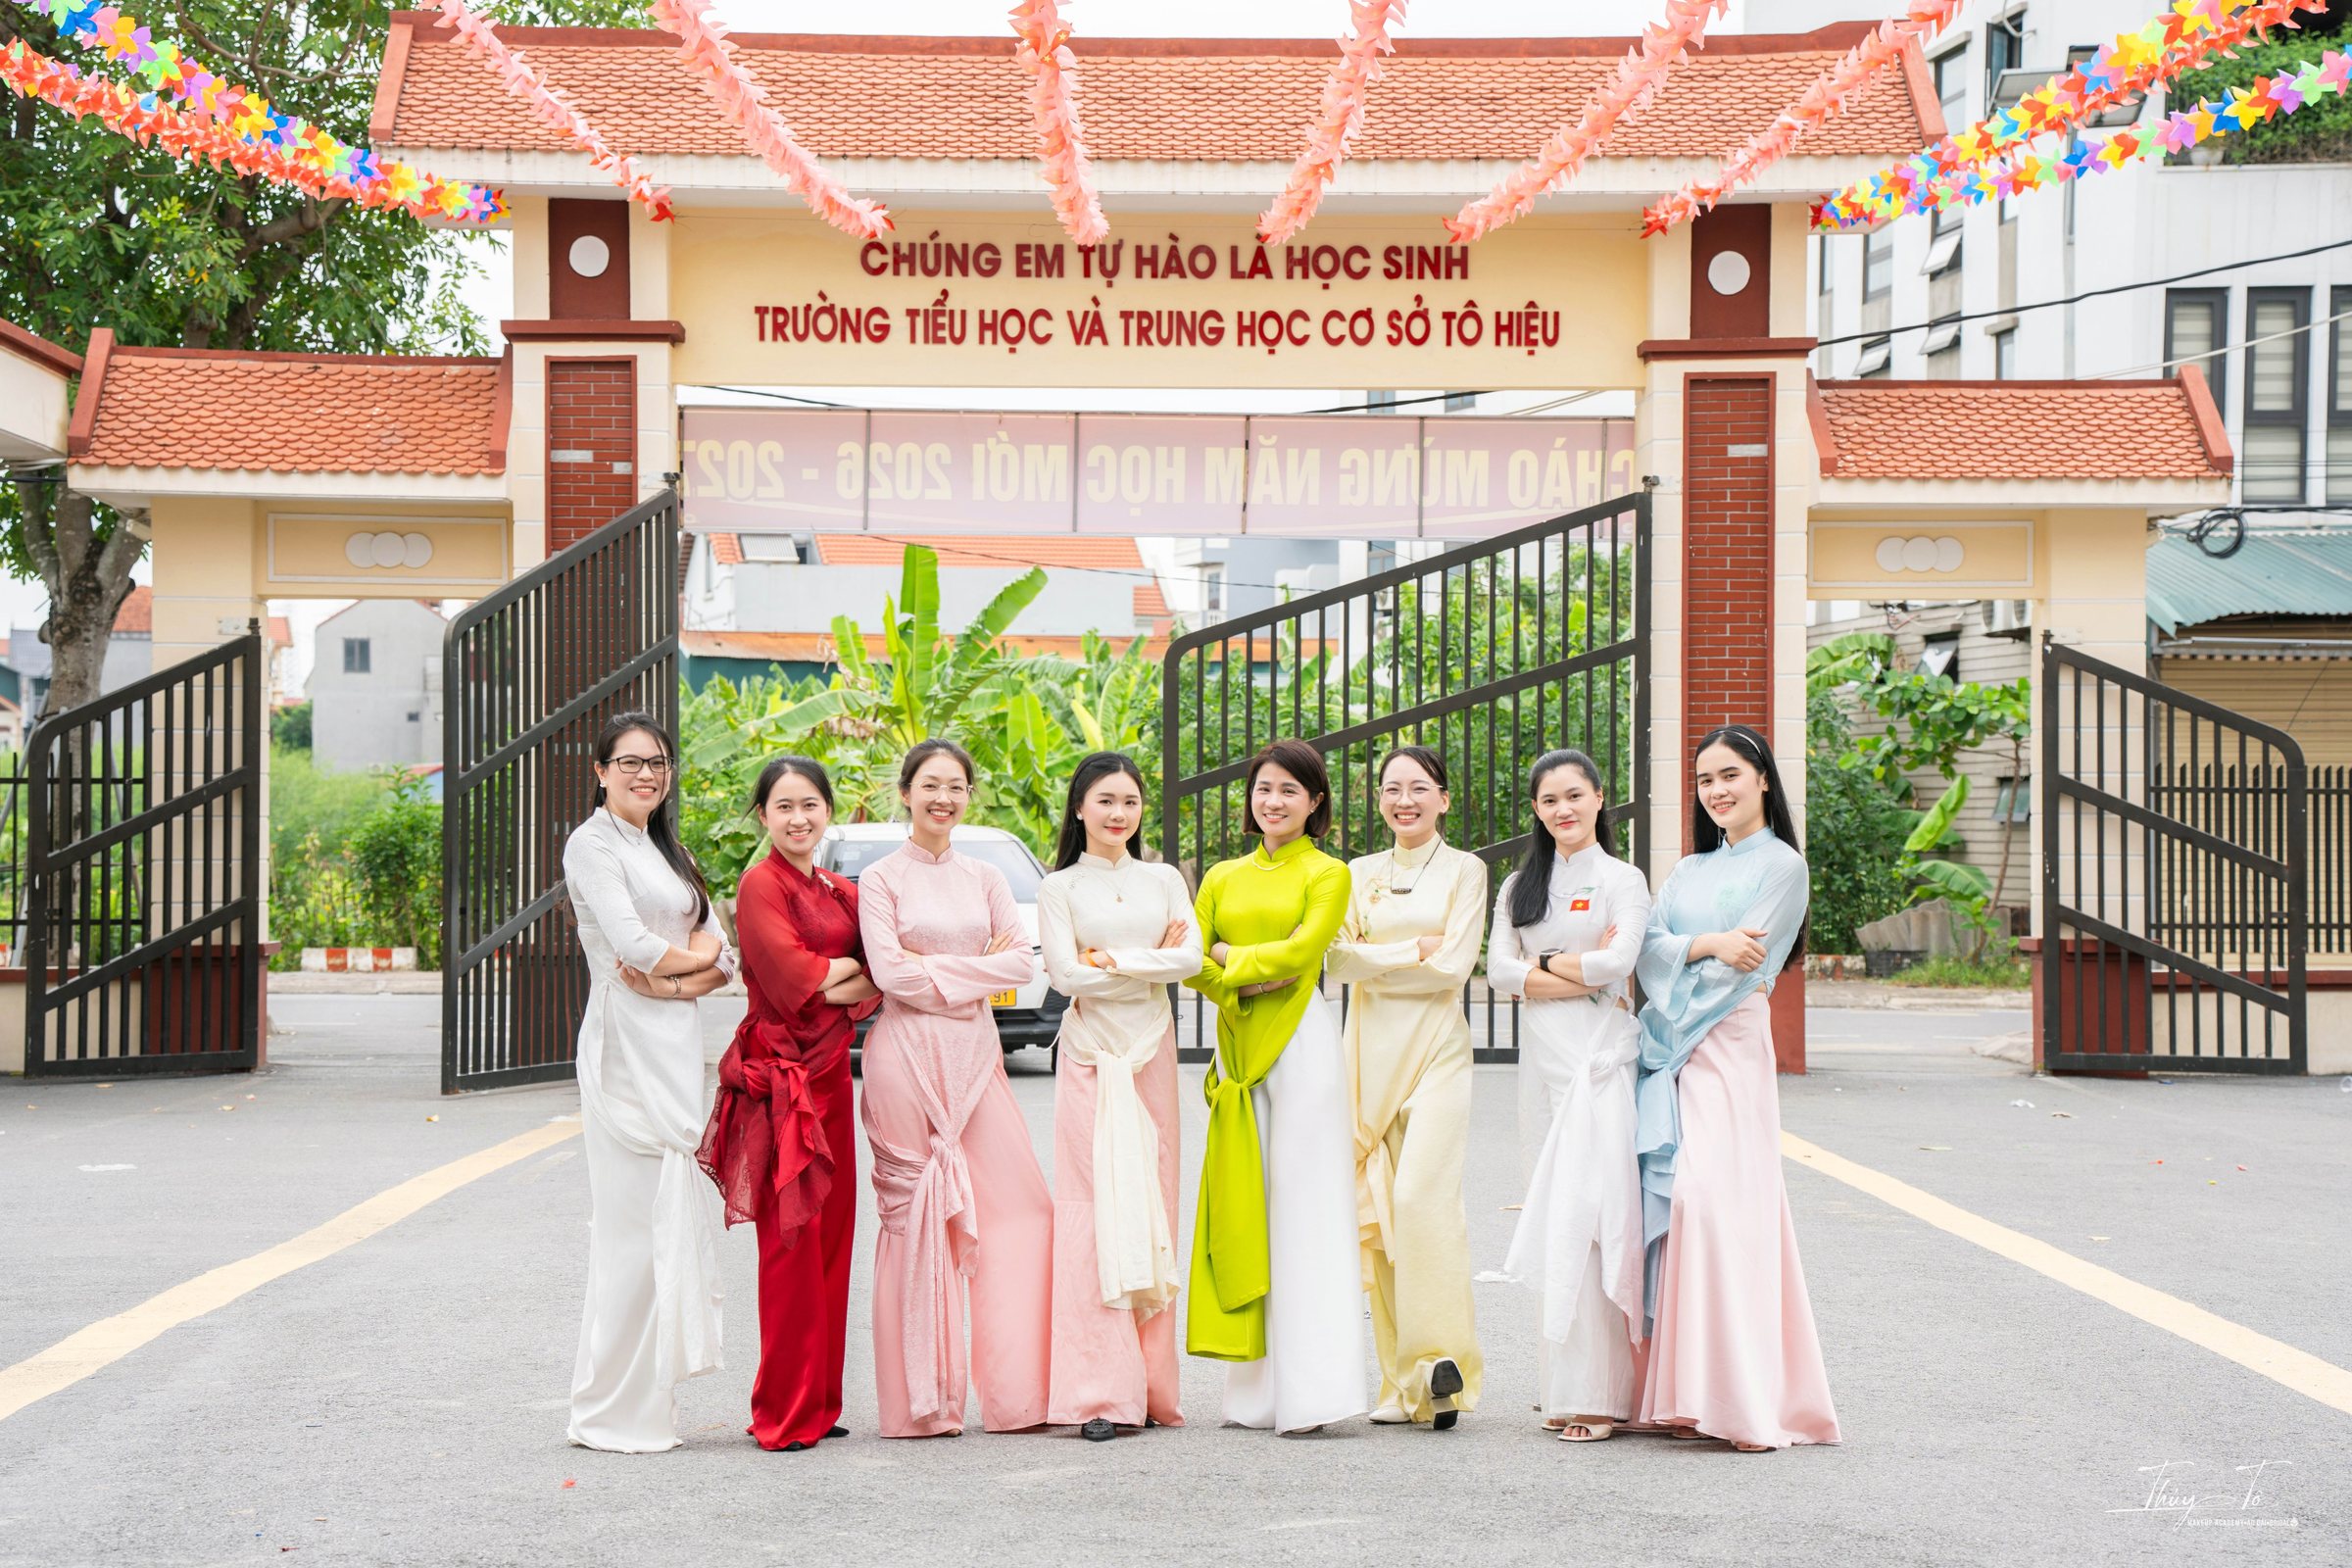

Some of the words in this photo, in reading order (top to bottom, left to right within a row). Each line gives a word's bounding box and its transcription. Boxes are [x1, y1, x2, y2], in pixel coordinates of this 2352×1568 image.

[859, 230, 1002, 278] CHÚNG
[1014, 243, 1065, 279] EM
[1077, 239, 1124, 288] TỰ
[1134, 232, 1217, 281] HÀO
[1230, 234, 1274, 281] LÀ
[1285, 245, 1371, 290] HỌC
[1382, 244, 1469, 281] SINH
[754, 290, 891, 344] TRƯỜNG
[906, 288, 967, 345] TIỂU
[978, 308, 1053, 354] HỌC
[1066, 296, 1109, 346] VÀ
[1119, 310, 1225, 347] TRUNG
[1237, 310, 1310, 355] HỌC
[1321, 306, 1375, 347] CƠ
[1386, 294, 1432, 347] SỞ
[1442, 299, 1484, 347] TÔ
[1494, 300, 1560, 356] HIỆU
